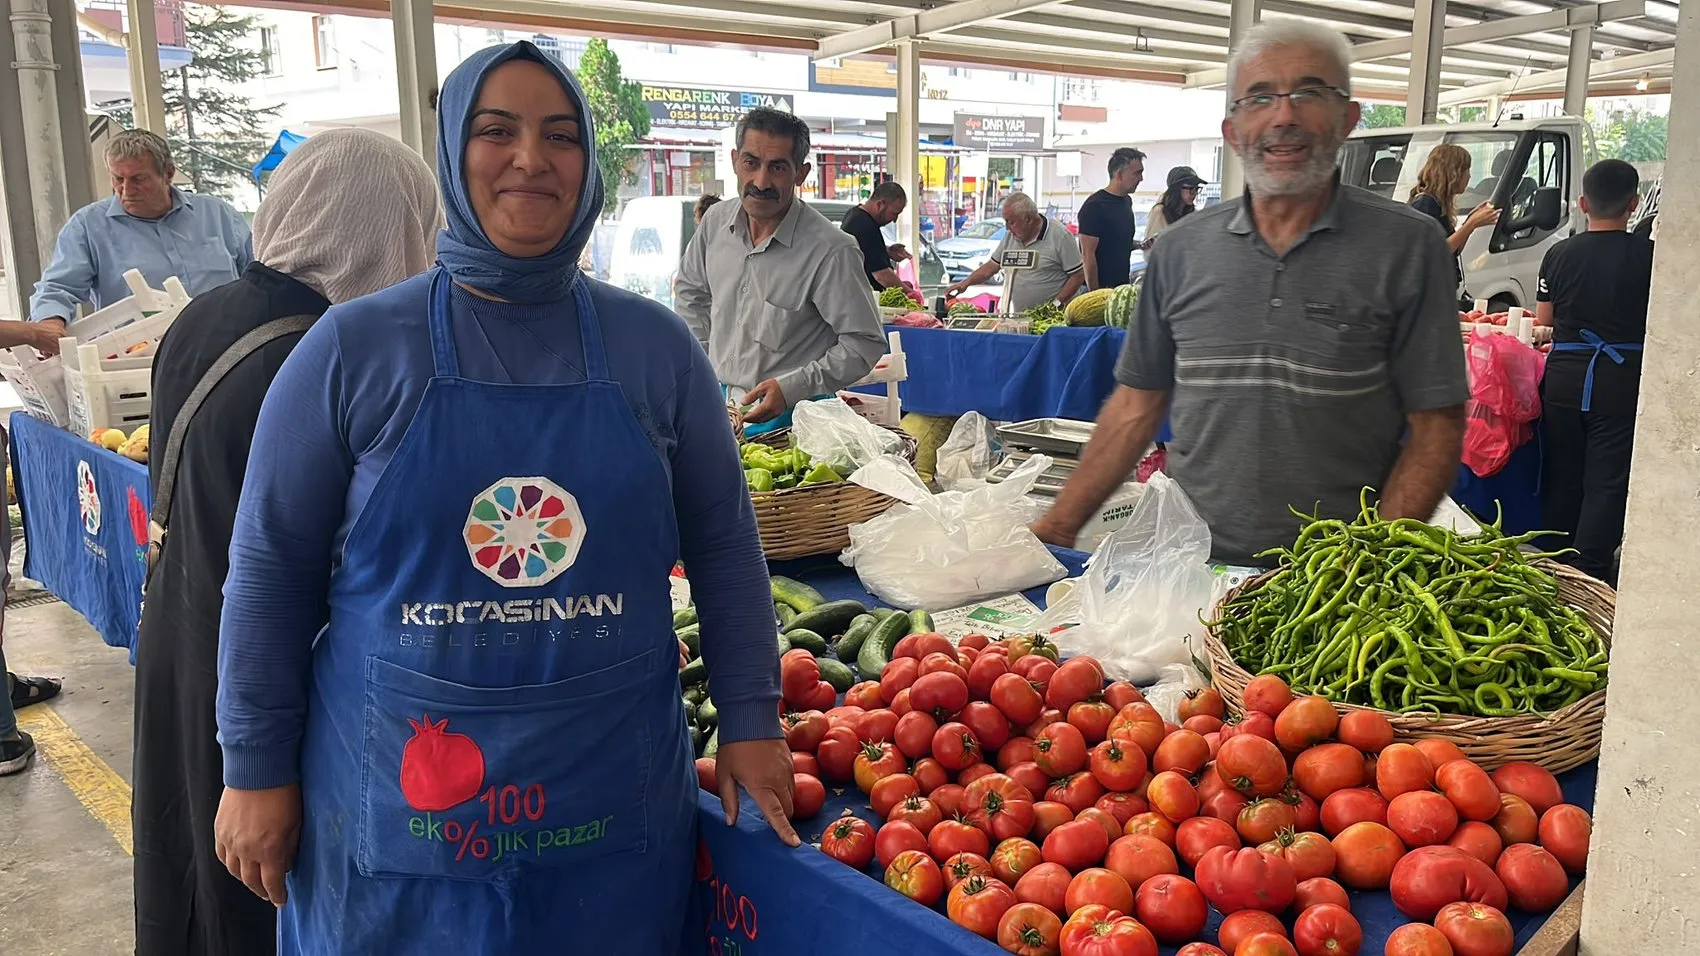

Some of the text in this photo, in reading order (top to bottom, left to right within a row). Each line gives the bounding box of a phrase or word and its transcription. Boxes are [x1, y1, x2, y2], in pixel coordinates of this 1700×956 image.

[641, 86, 775, 108] RENGARENK BOYA
[663, 102, 696, 111] YAPI
[670, 112, 697, 120] 0554
[700, 113, 720, 121] 644
[723, 113, 736, 121] 67
[982, 119, 1004, 131] DNR
[1004, 120, 1025, 132] YAPI
[480, 784, 545, 825] 100
[537, 815, 614, 857] pazar
[710, 876, 757, 940] 100
